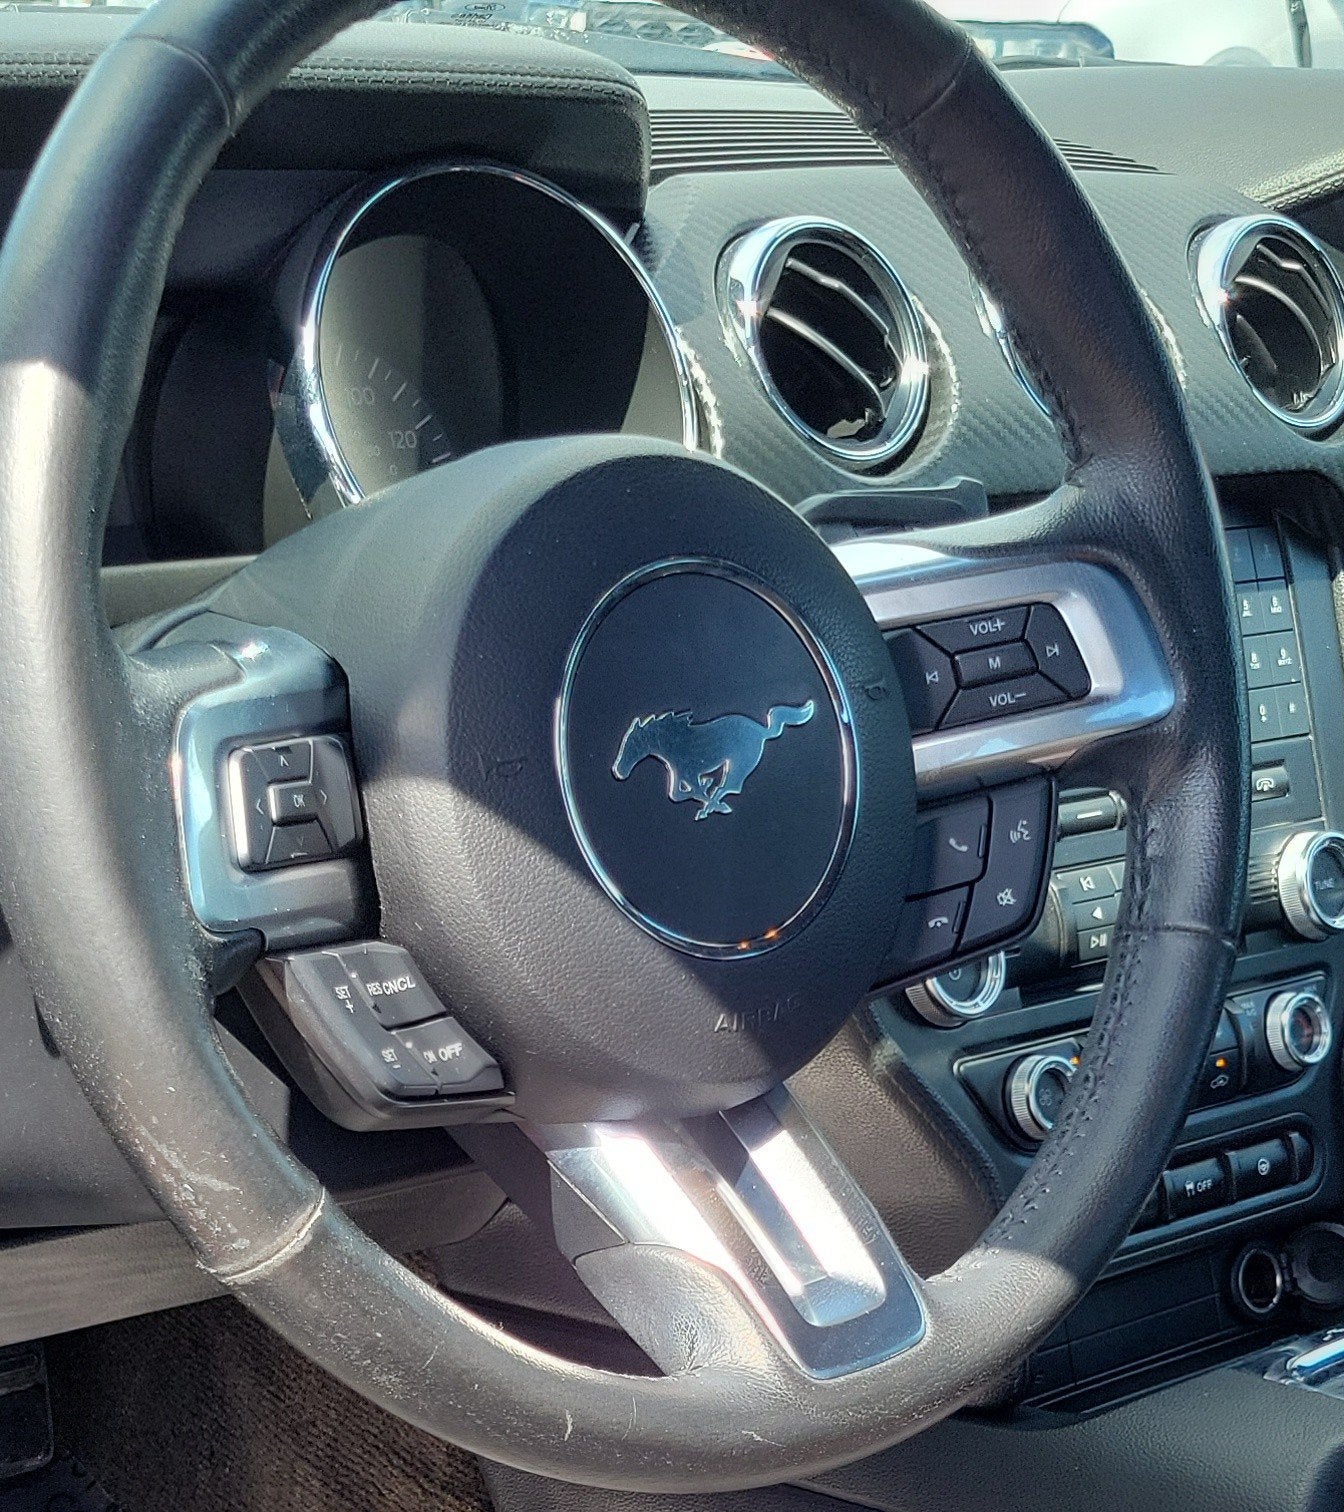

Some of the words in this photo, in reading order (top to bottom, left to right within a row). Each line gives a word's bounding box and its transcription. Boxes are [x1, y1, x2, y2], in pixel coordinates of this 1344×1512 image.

[387, 430, 417, 449] 120
[988, 656, 1001, 670] M
[293, 794, 306, 808] OK
[334, 985, 351, 1000] SET
[366, 982, 383, 997] RES
[382, 976, 416, 995] CNCL
[381, 1048, 399, 1063] SET
[422, 1050, 438, 1064] ON
[438, 1042, 463, 1062] OFF
[1196, 1179, 1213, 1193] OFF
